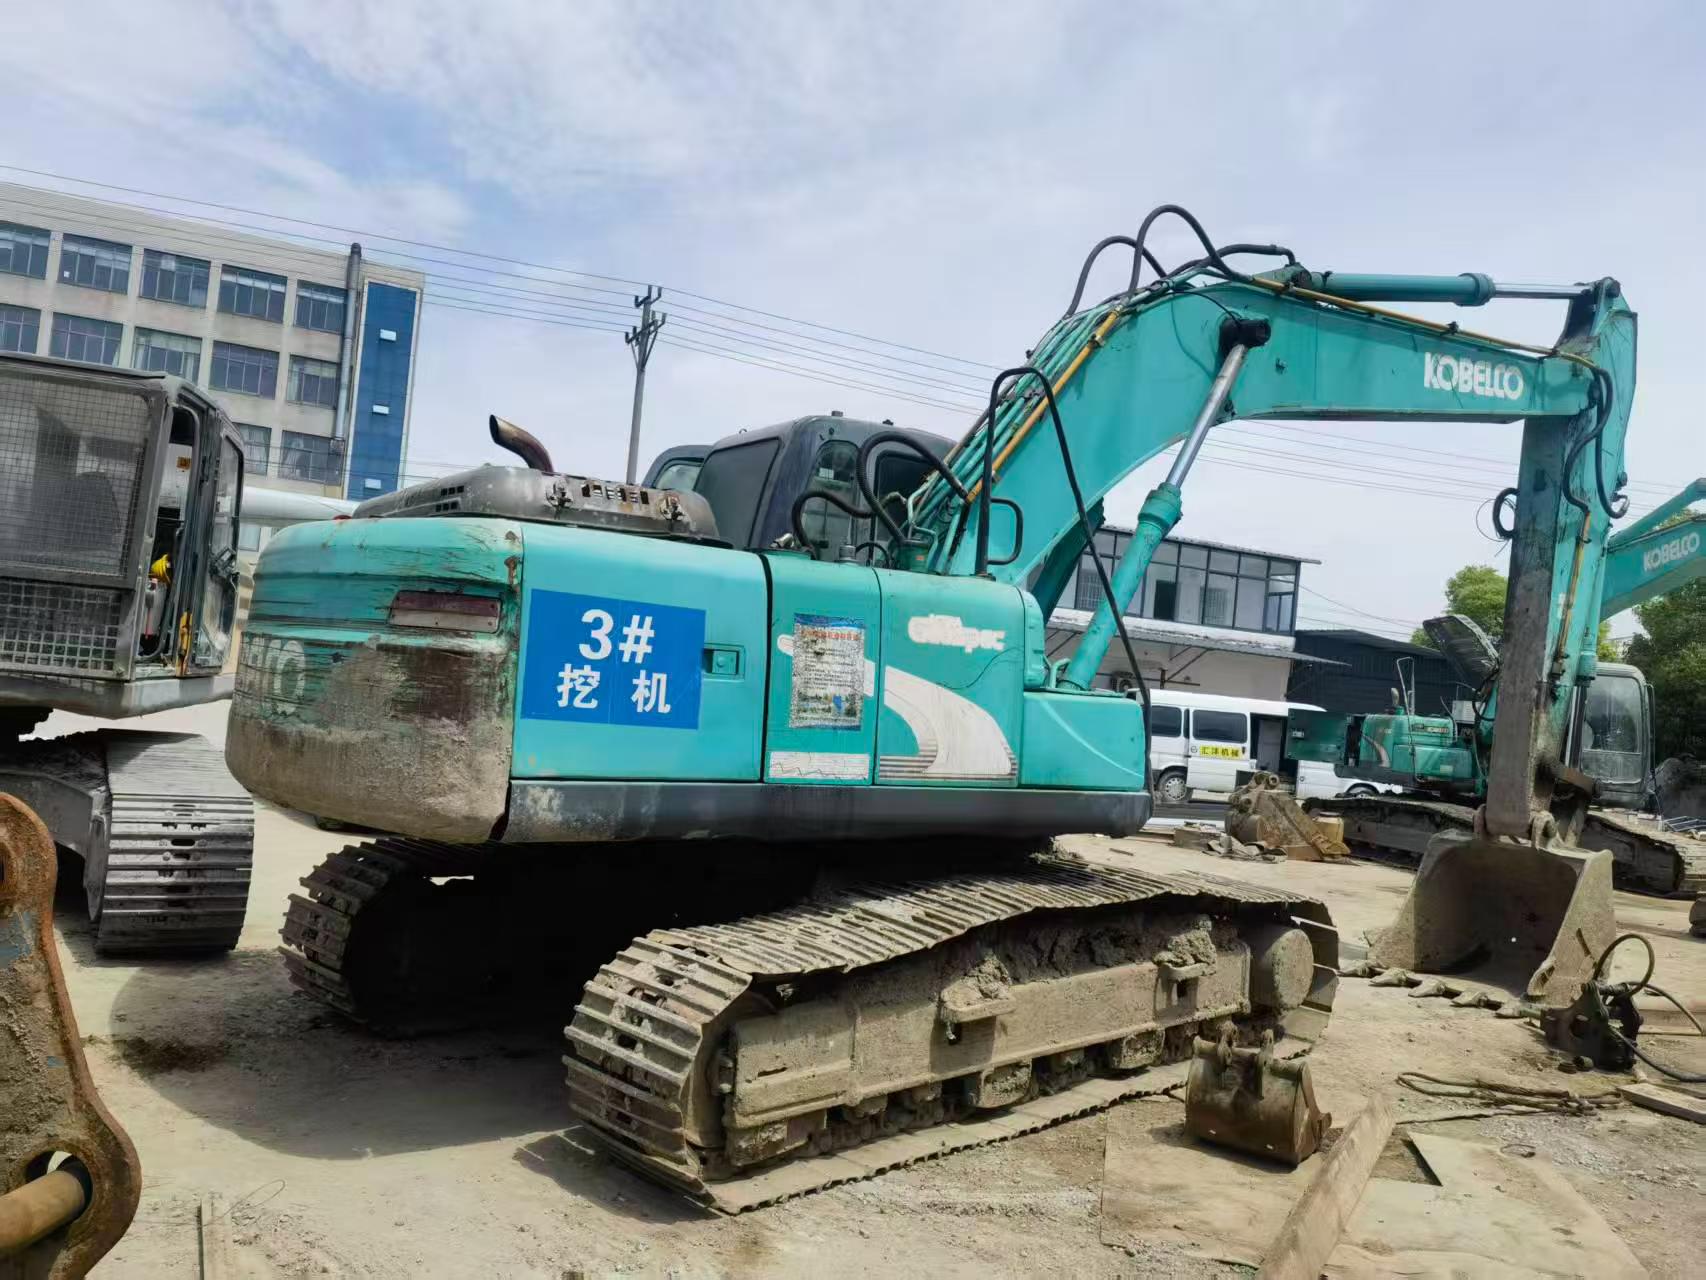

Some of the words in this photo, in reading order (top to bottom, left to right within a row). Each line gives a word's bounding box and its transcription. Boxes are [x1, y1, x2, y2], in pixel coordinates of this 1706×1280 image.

[1423, 351, 1524, 401] KOBELCO
[578, 608, 656, 665] 3#
[556, 663, 672, 714] 挖机
